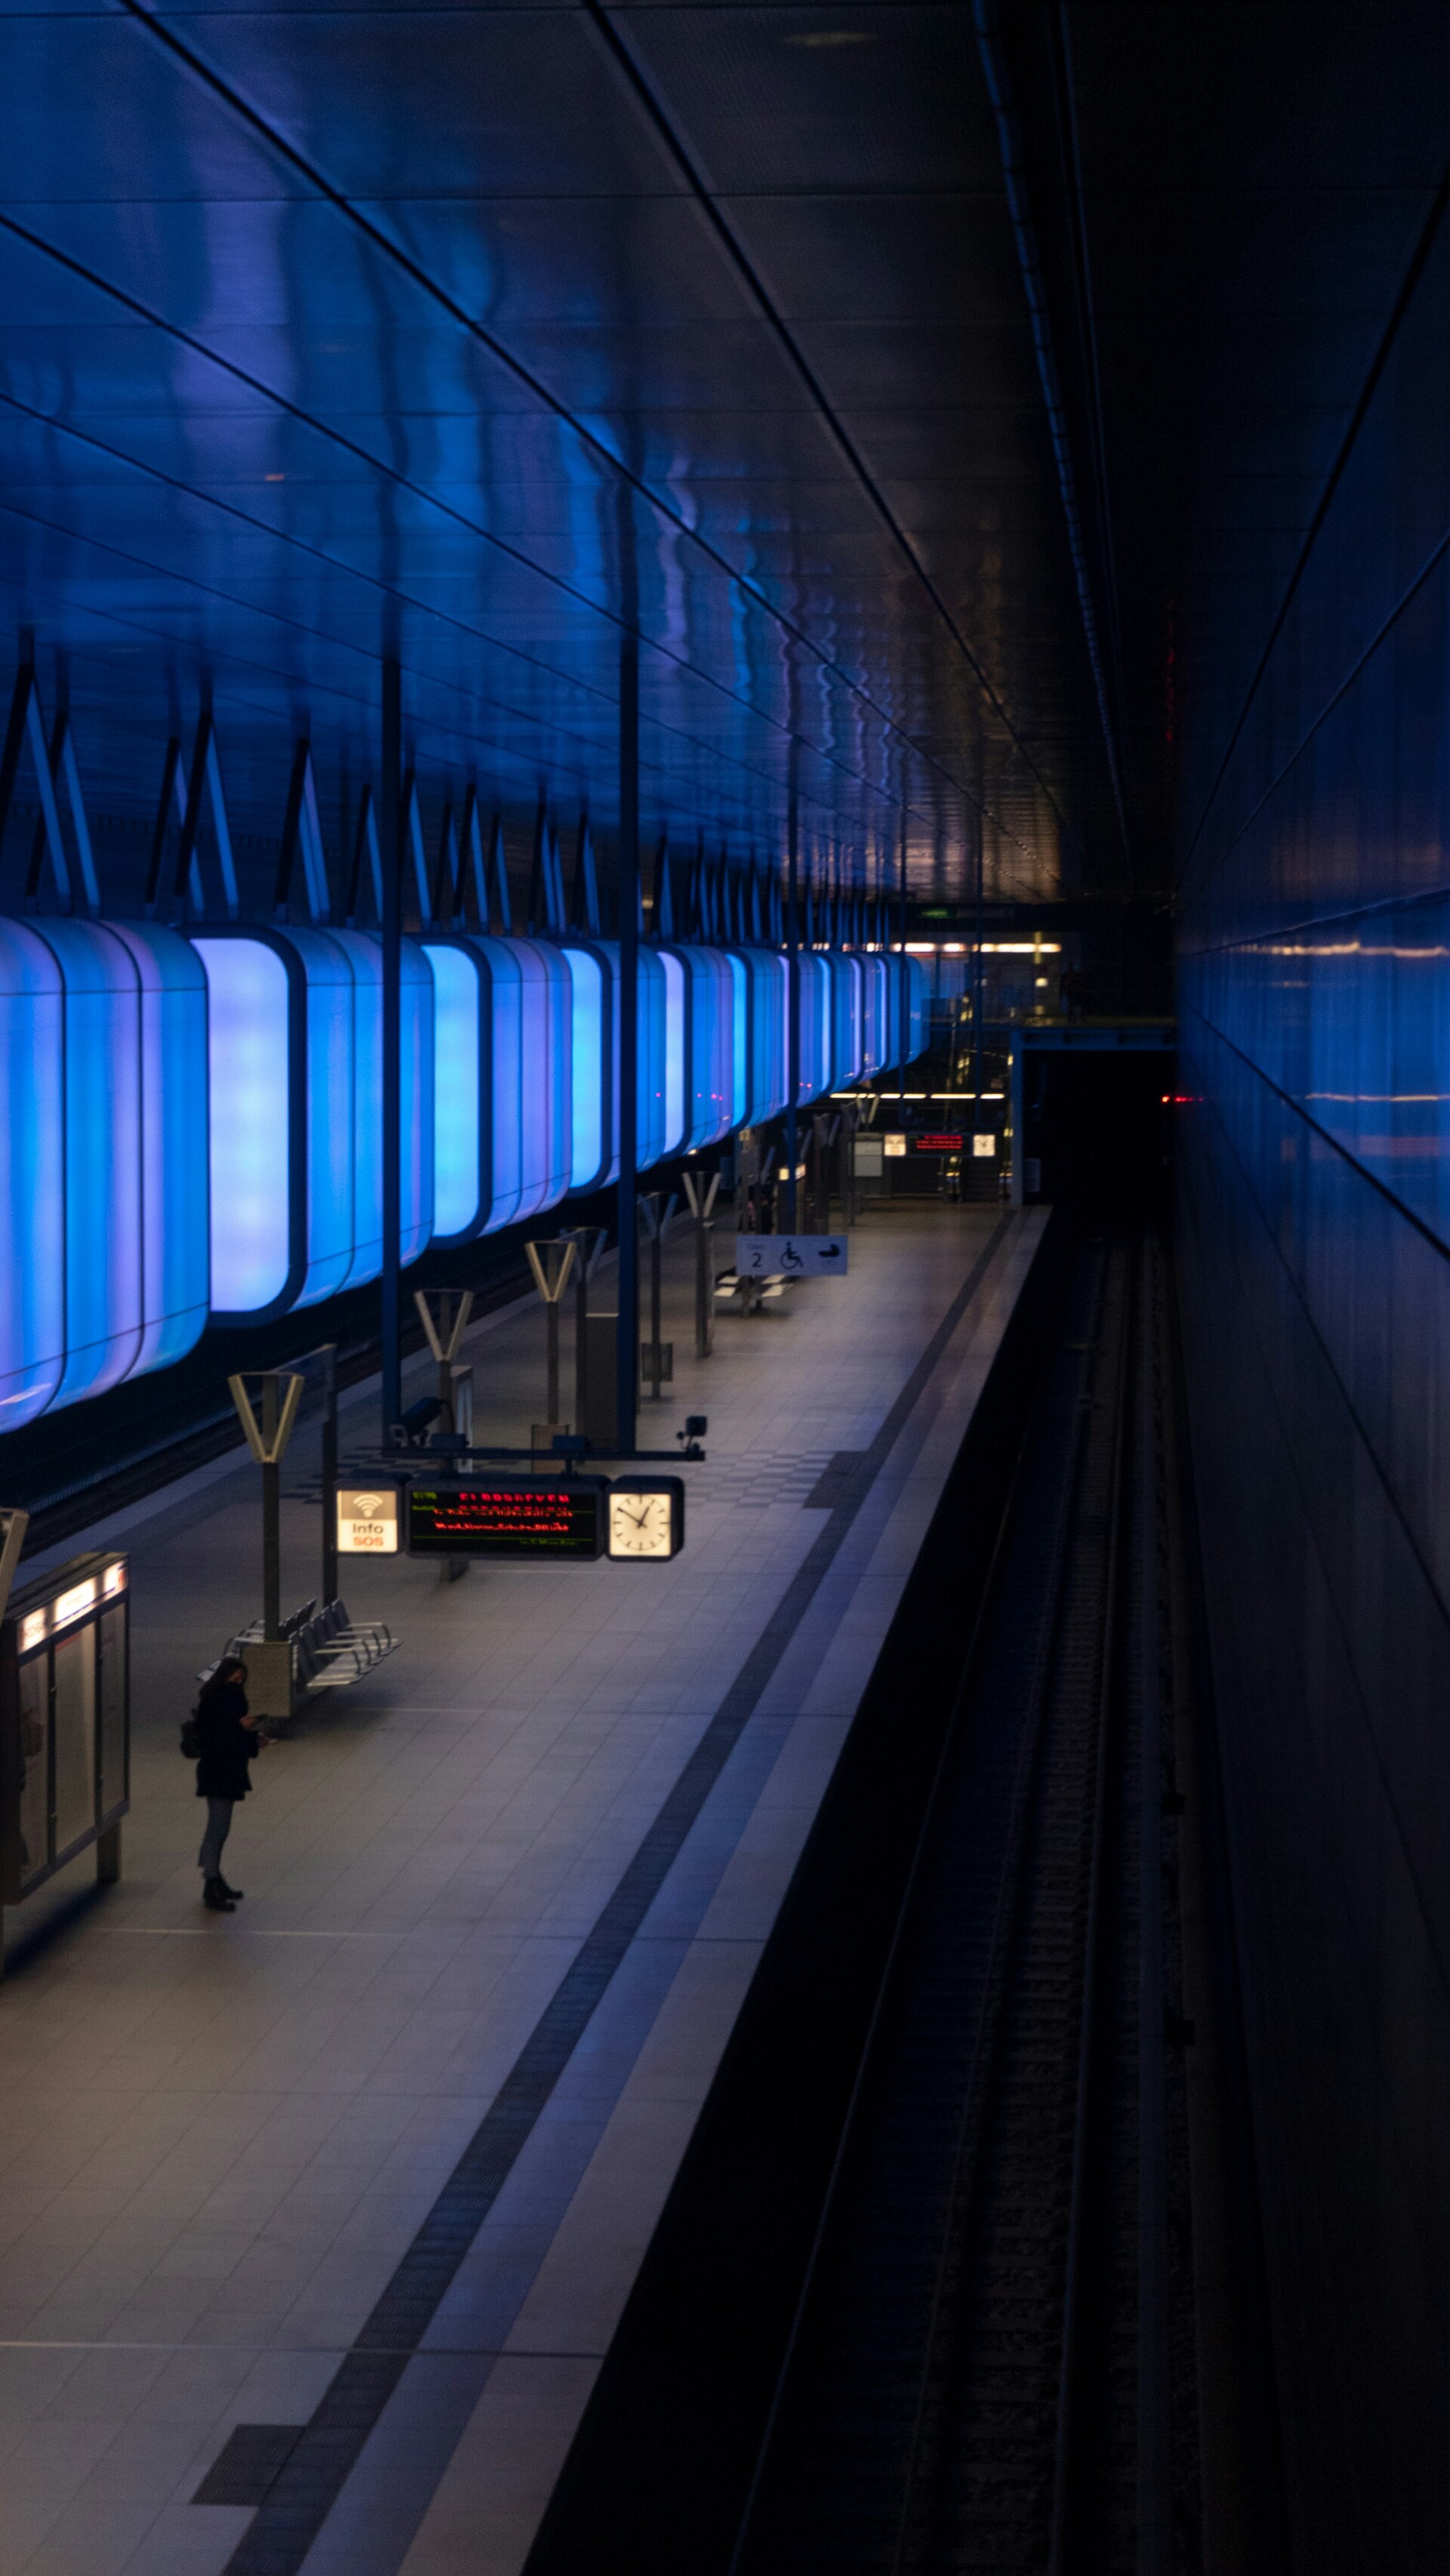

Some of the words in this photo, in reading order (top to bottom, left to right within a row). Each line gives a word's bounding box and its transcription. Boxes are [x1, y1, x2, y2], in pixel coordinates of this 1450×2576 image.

[752, 1251, 762, 1268] 2
[353, 1524, 384, 1534] Info
[353, 1536, 384, 1546] SOS
